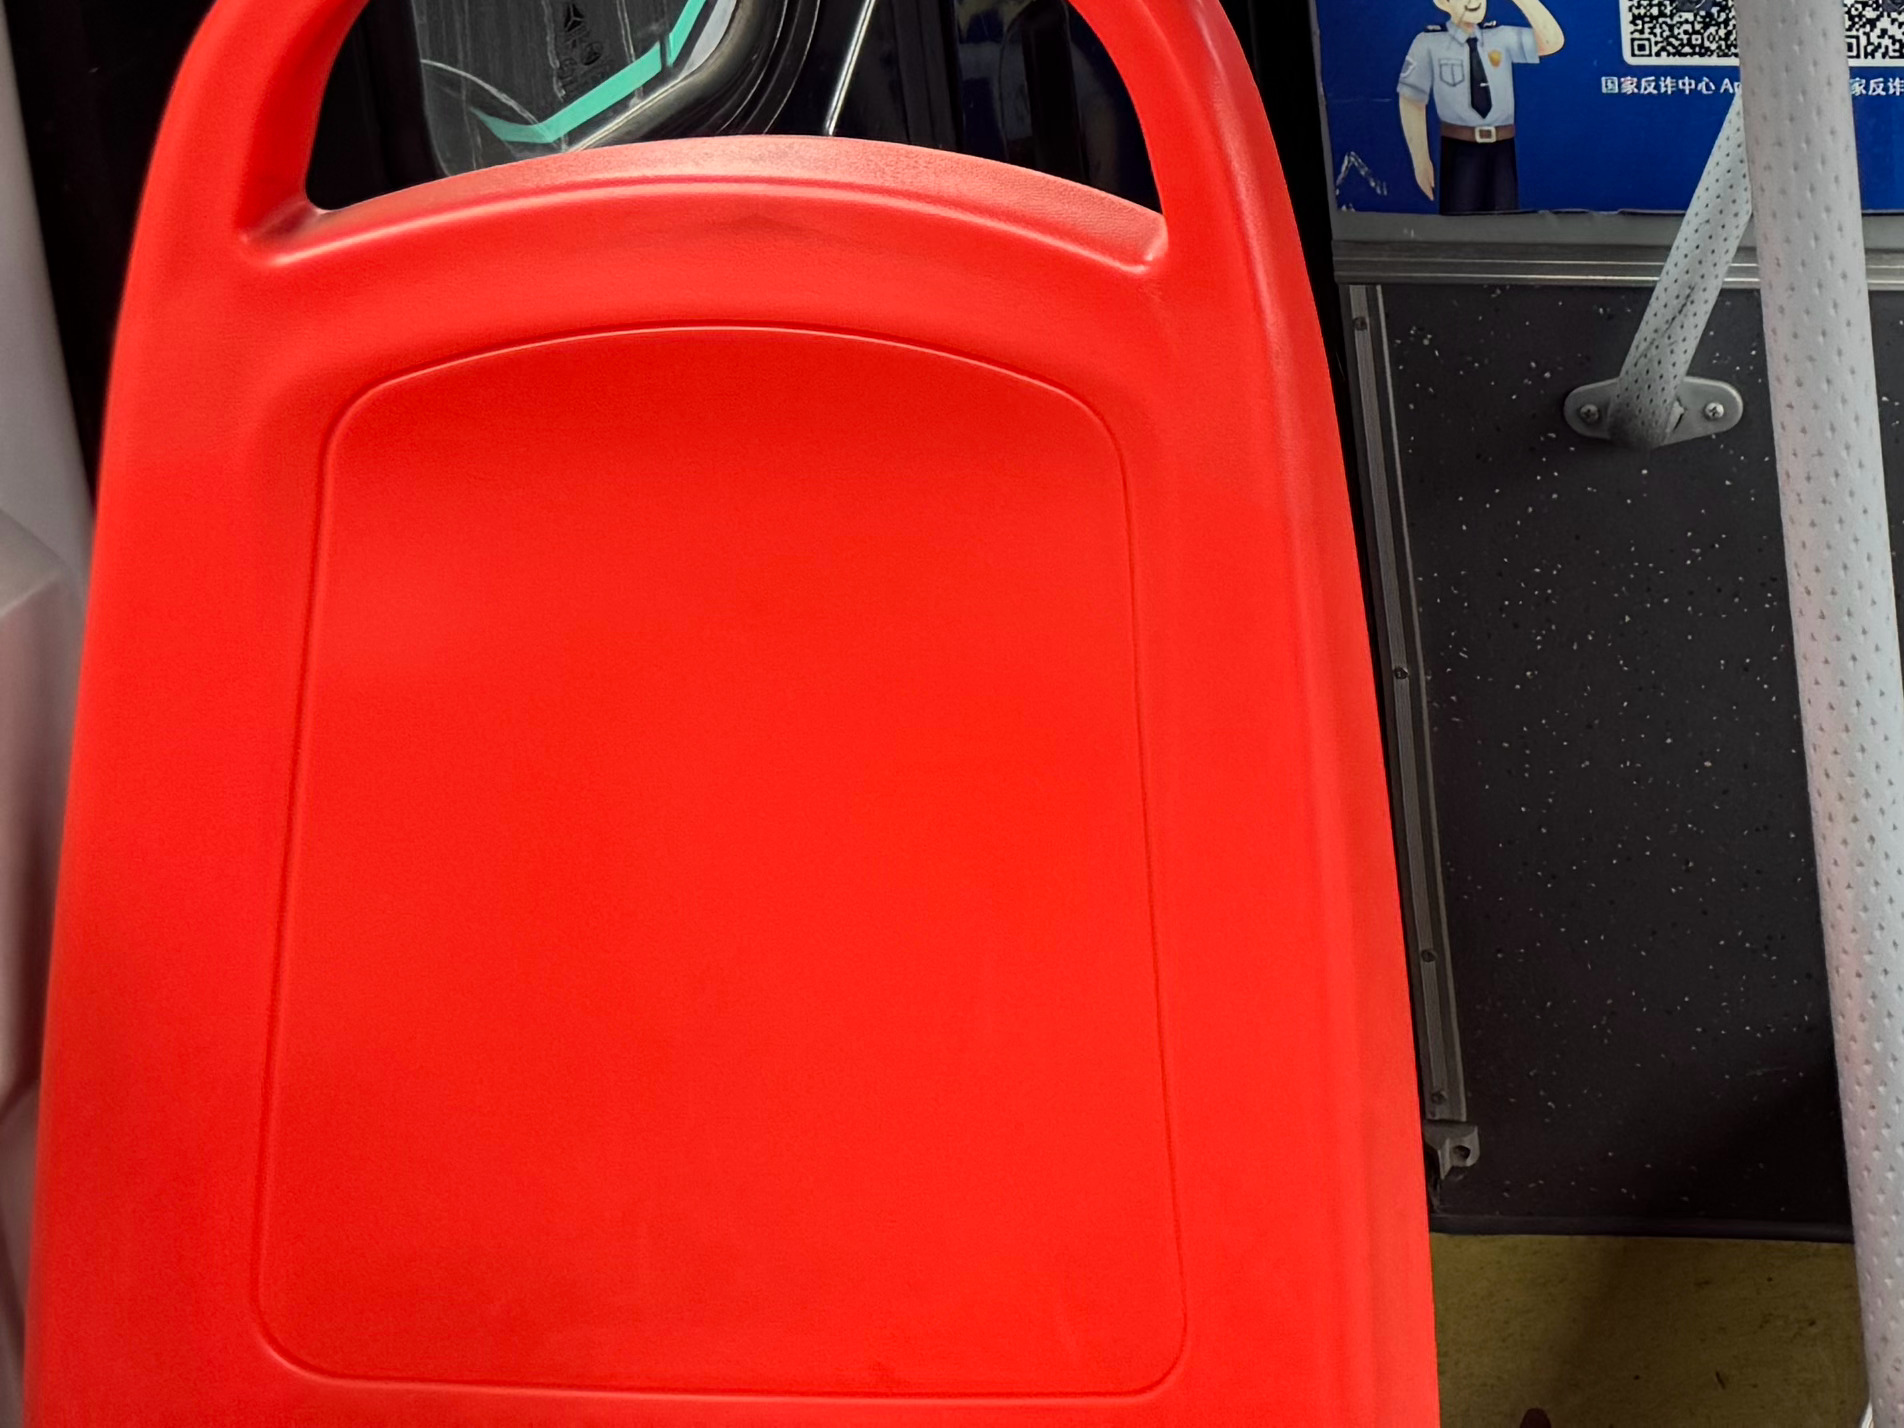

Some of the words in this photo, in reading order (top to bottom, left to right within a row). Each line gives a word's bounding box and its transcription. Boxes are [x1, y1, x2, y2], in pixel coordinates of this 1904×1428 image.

[1601, 76, 1716, 96] 国家反诈中心
